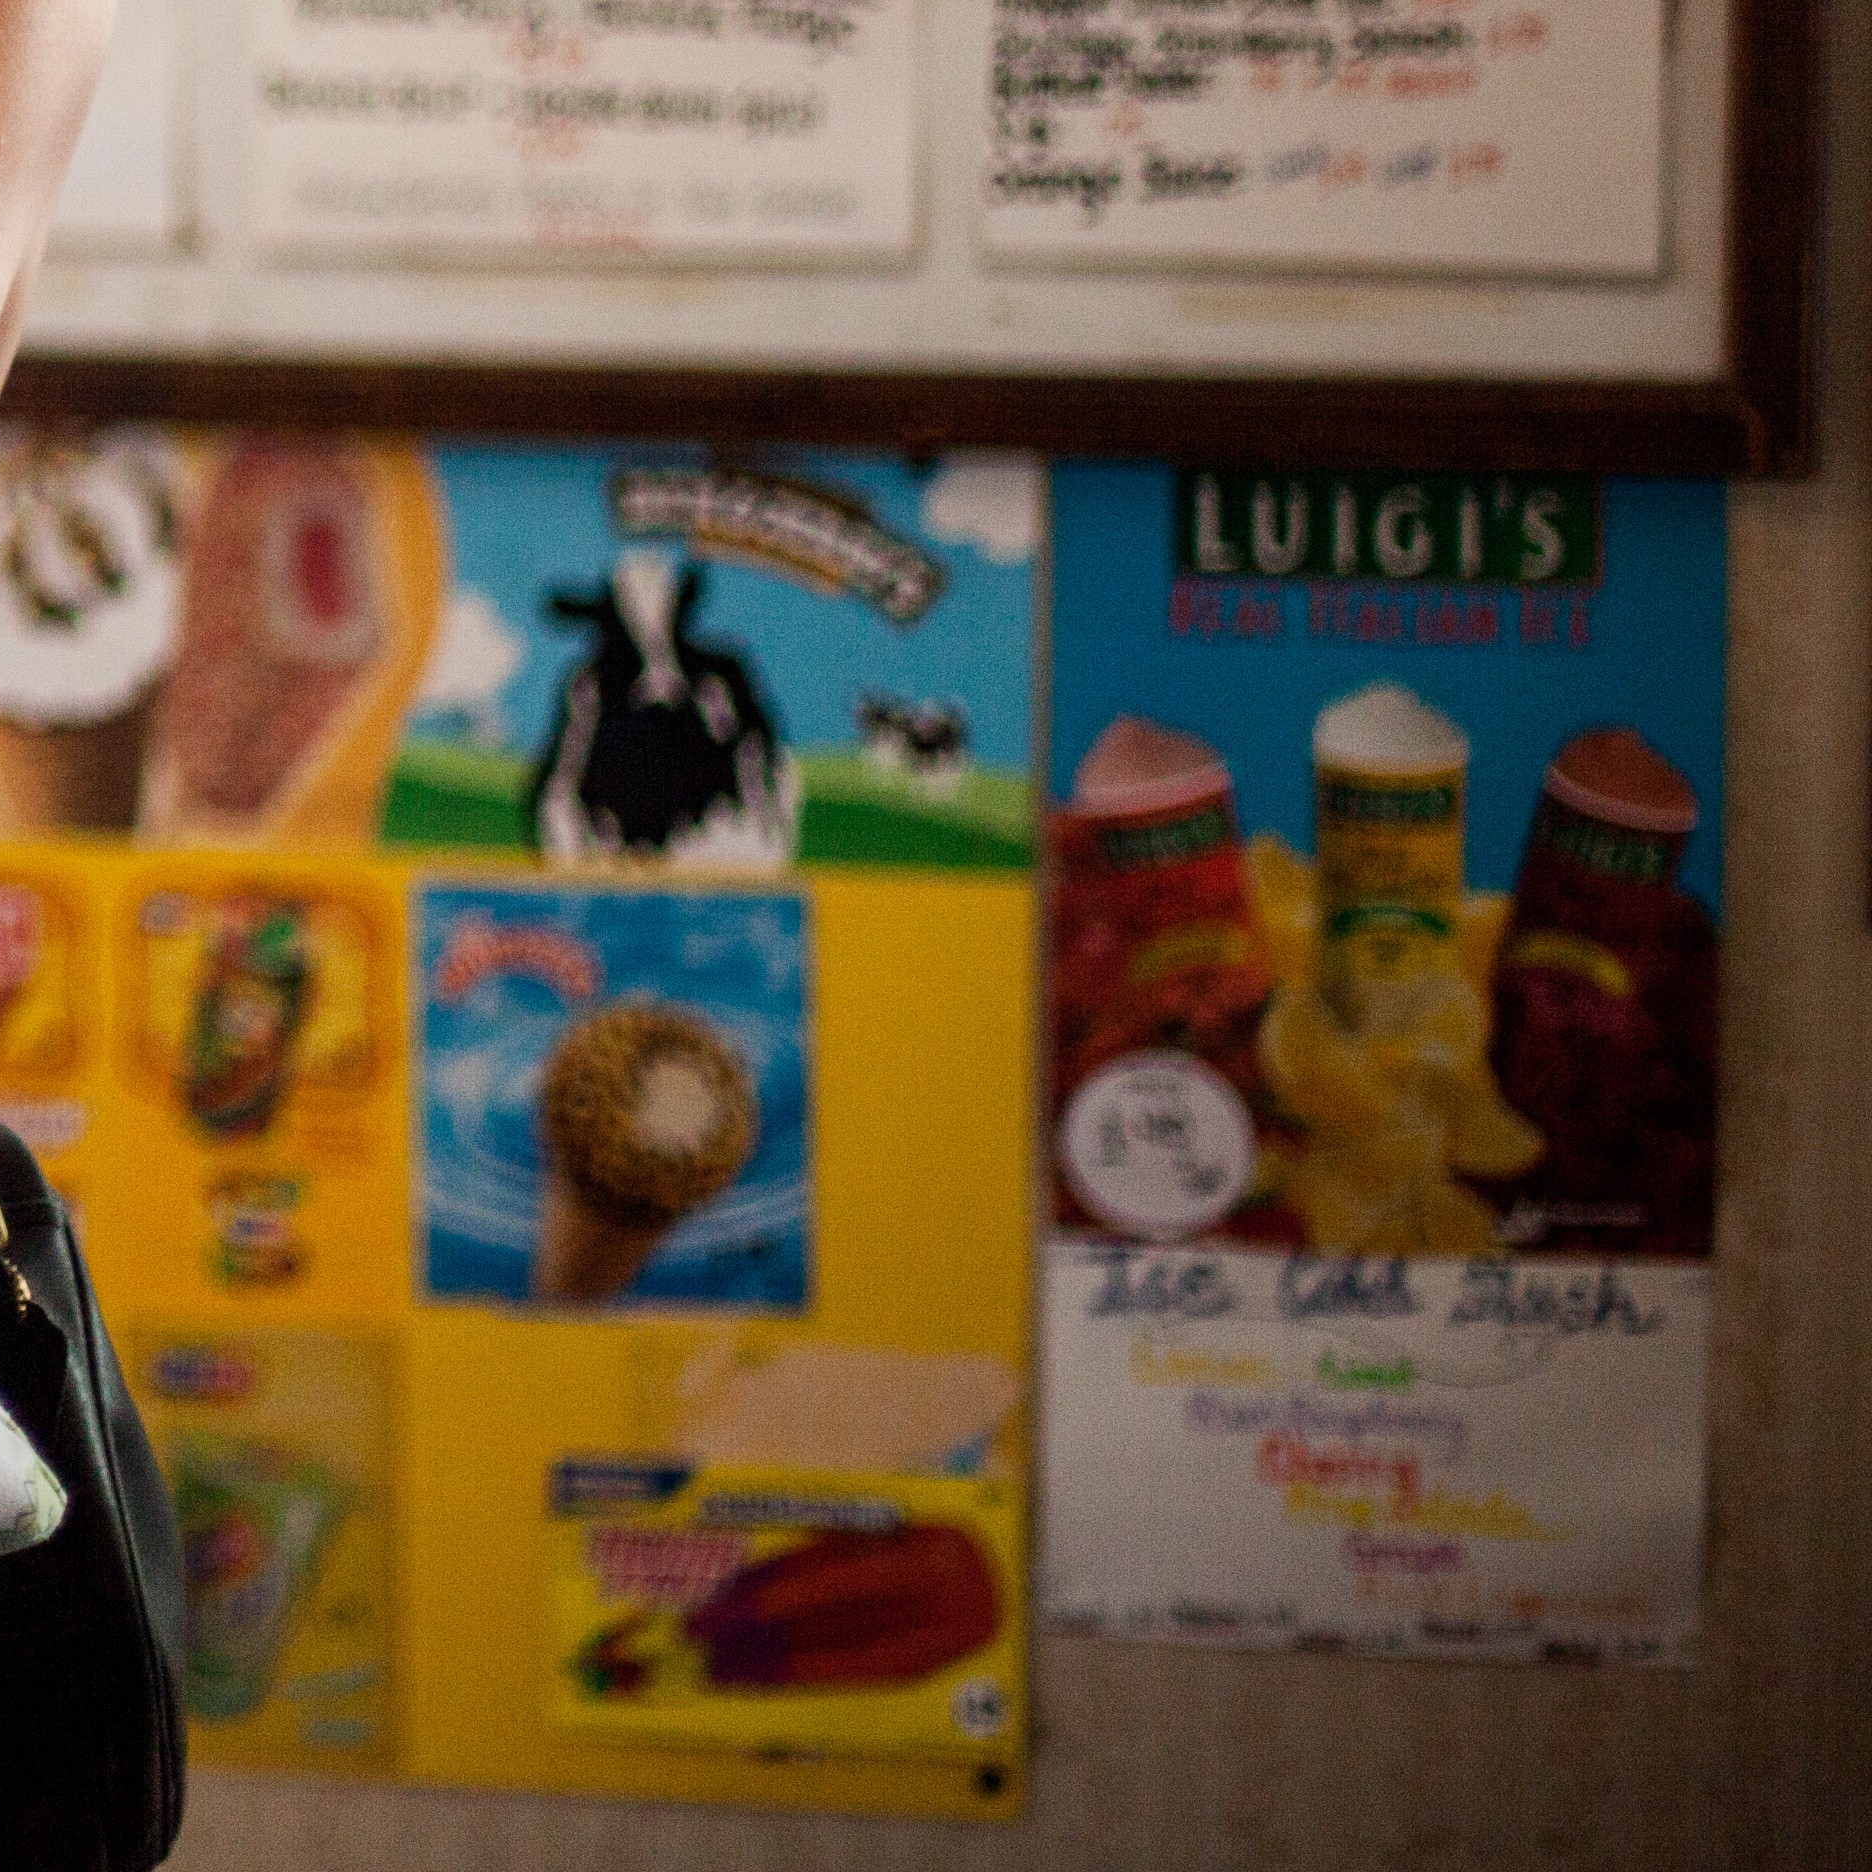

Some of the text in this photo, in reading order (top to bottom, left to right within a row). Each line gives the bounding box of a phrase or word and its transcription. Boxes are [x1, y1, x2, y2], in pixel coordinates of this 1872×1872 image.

[1194, 473, 1566, 580] LUIGI'S
[1088, 1252, 1664, 1336] Ice Cold Slush
